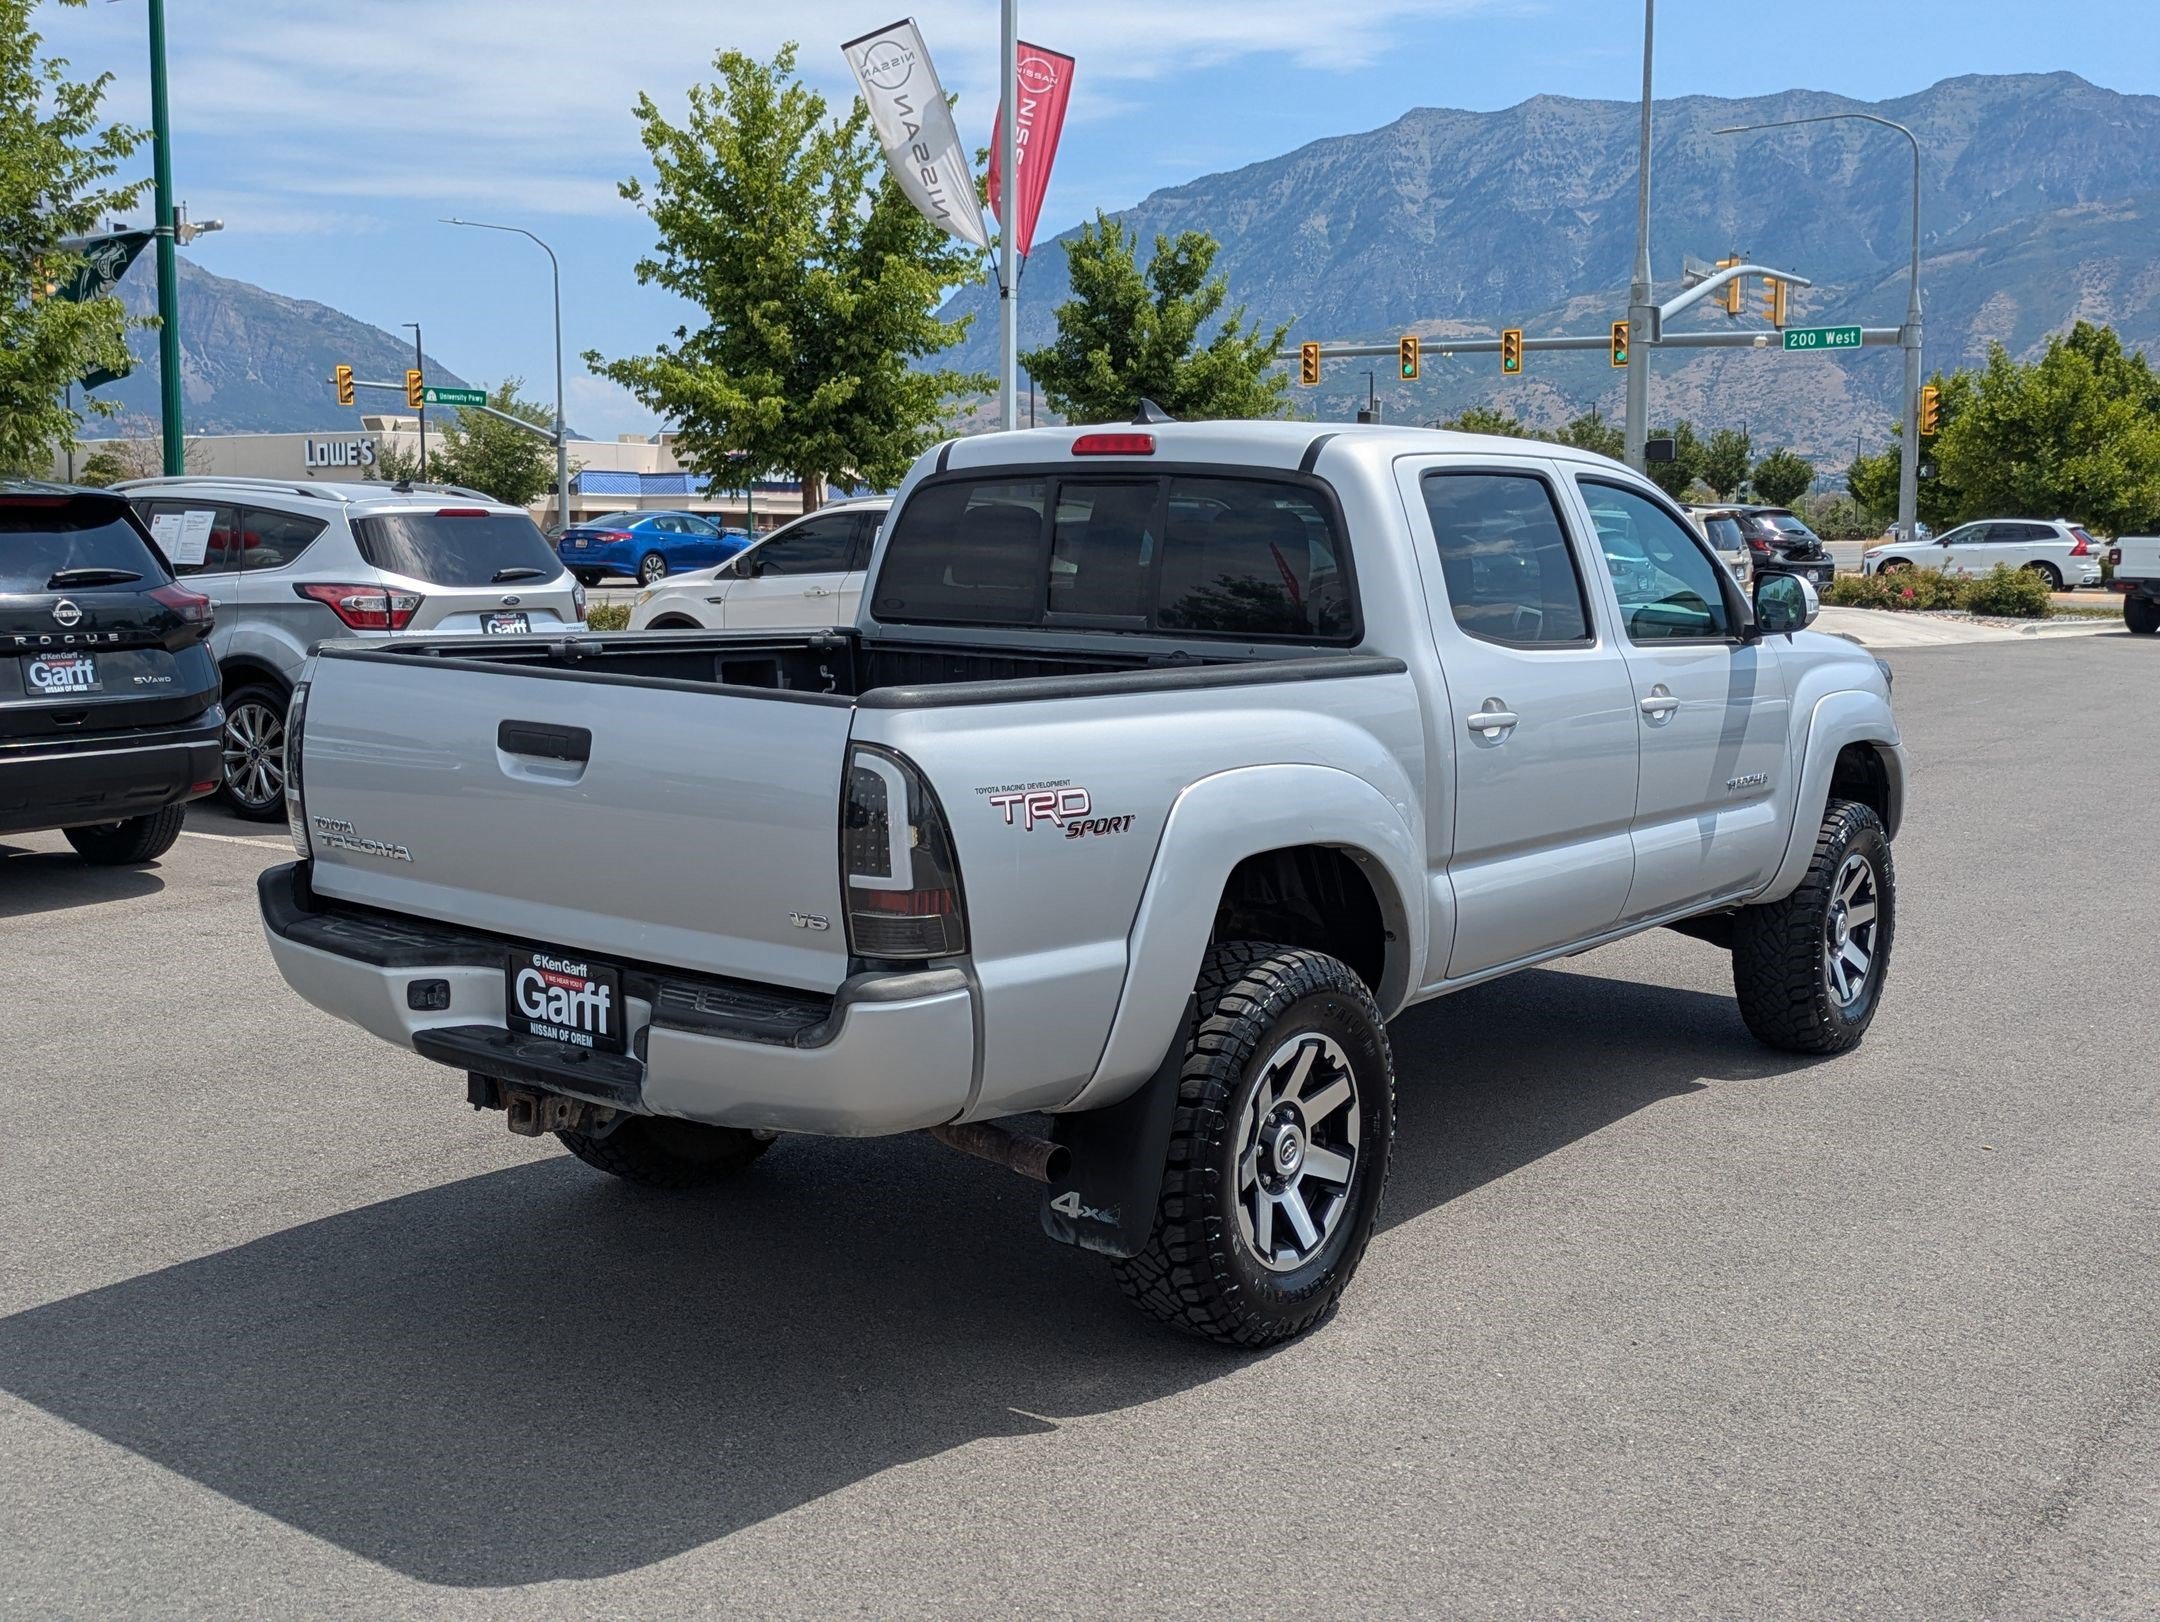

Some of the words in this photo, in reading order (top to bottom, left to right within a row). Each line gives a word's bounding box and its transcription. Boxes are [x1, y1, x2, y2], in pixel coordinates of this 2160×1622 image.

[1790, 332, 1817, 348] 200
[1825, 330, 1857, 346] West
[439, 392, 467, 403] University
[468, 394, 484, 404] Pkwy
[304, 438, 376, 467] LOWE'S
[52, 609, 83, 618] NISSAN
[14, 633, 120, 646] ROGUE
[29, 659, 94, 687] Garff
[975, 786, 1000, 795] TOYOTA
[1001, 783, 1026, 792] RACING
[1027, 779, 1071, 790] DEVELOPMENT
[989, 787, 1092, 831] TRD
[314, 815, 356, 834] TOYOTA
[1065, 814, 1137, 840] SPORT
[317, 831, 414, 862] TACOMA
[789, 911, 830, 931] V6
[541, 955, 561, 971] Ken
[562, 960, 588, 977] Garff
[516, 968, 610, 1034] Garff
[530, 1022, 557, 1039] NISSAN
[559, 1029, 569, 1042] OF
[571, 1031, 593, 1048] OREM
